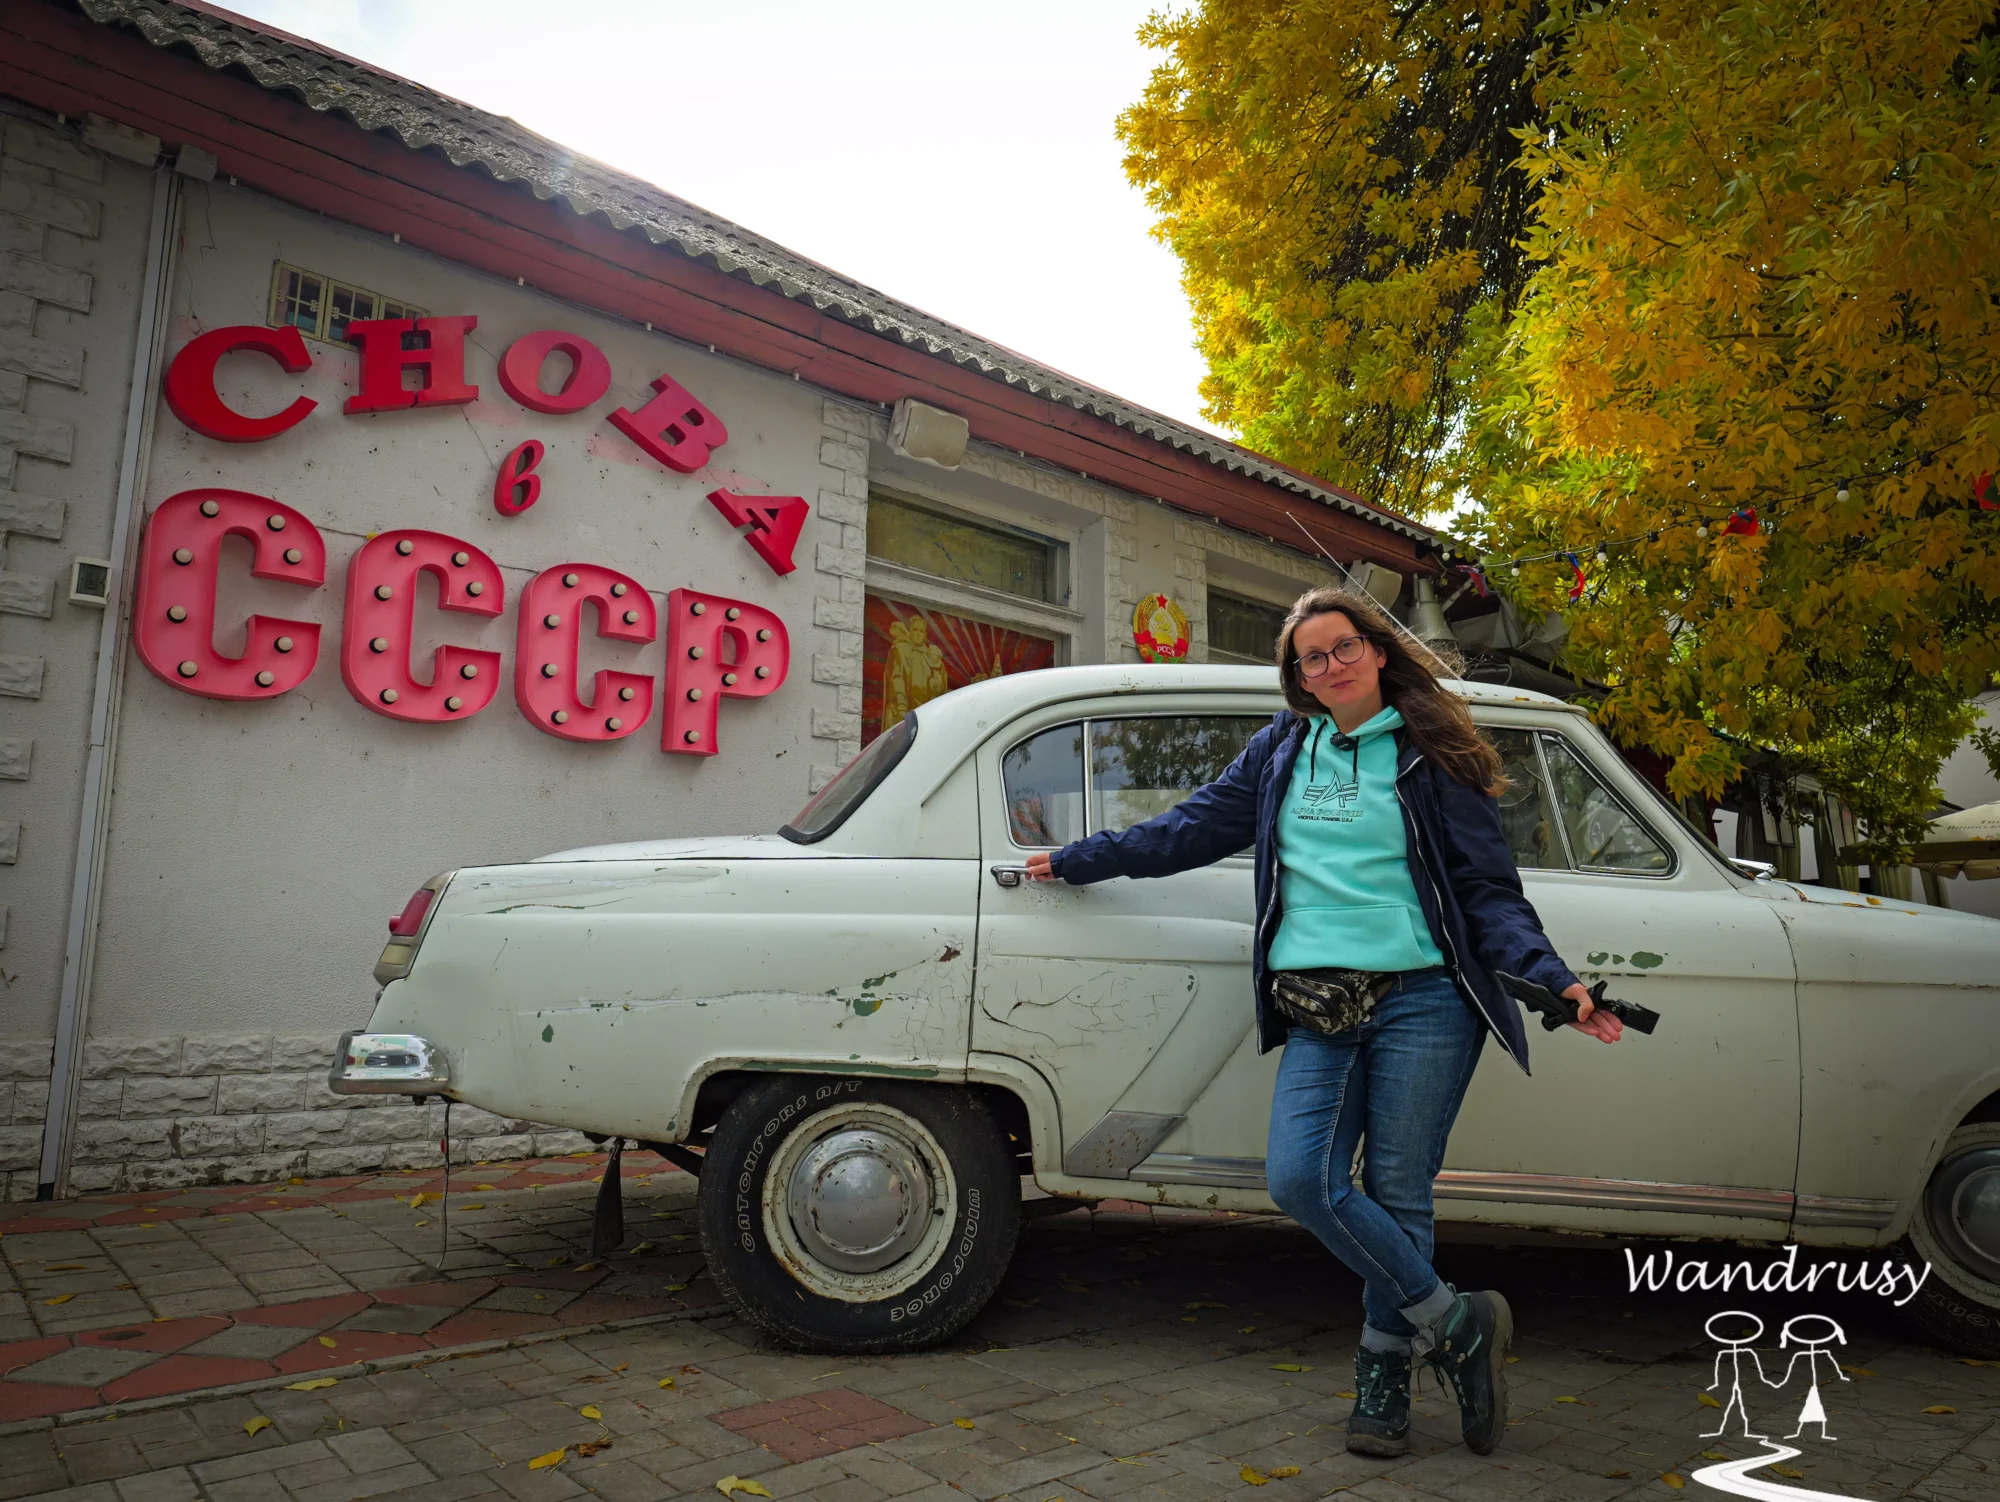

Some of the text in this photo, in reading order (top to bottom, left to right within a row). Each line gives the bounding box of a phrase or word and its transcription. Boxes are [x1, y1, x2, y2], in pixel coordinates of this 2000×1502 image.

[165, 315, 810, 576] СНОВА
[494, 439, 545, 517] в
[134, 488, 790, 756] СССР
[816, 1081, 862, 1100] A/T
[891, 1188, 980, 1322] WINDFORCE
